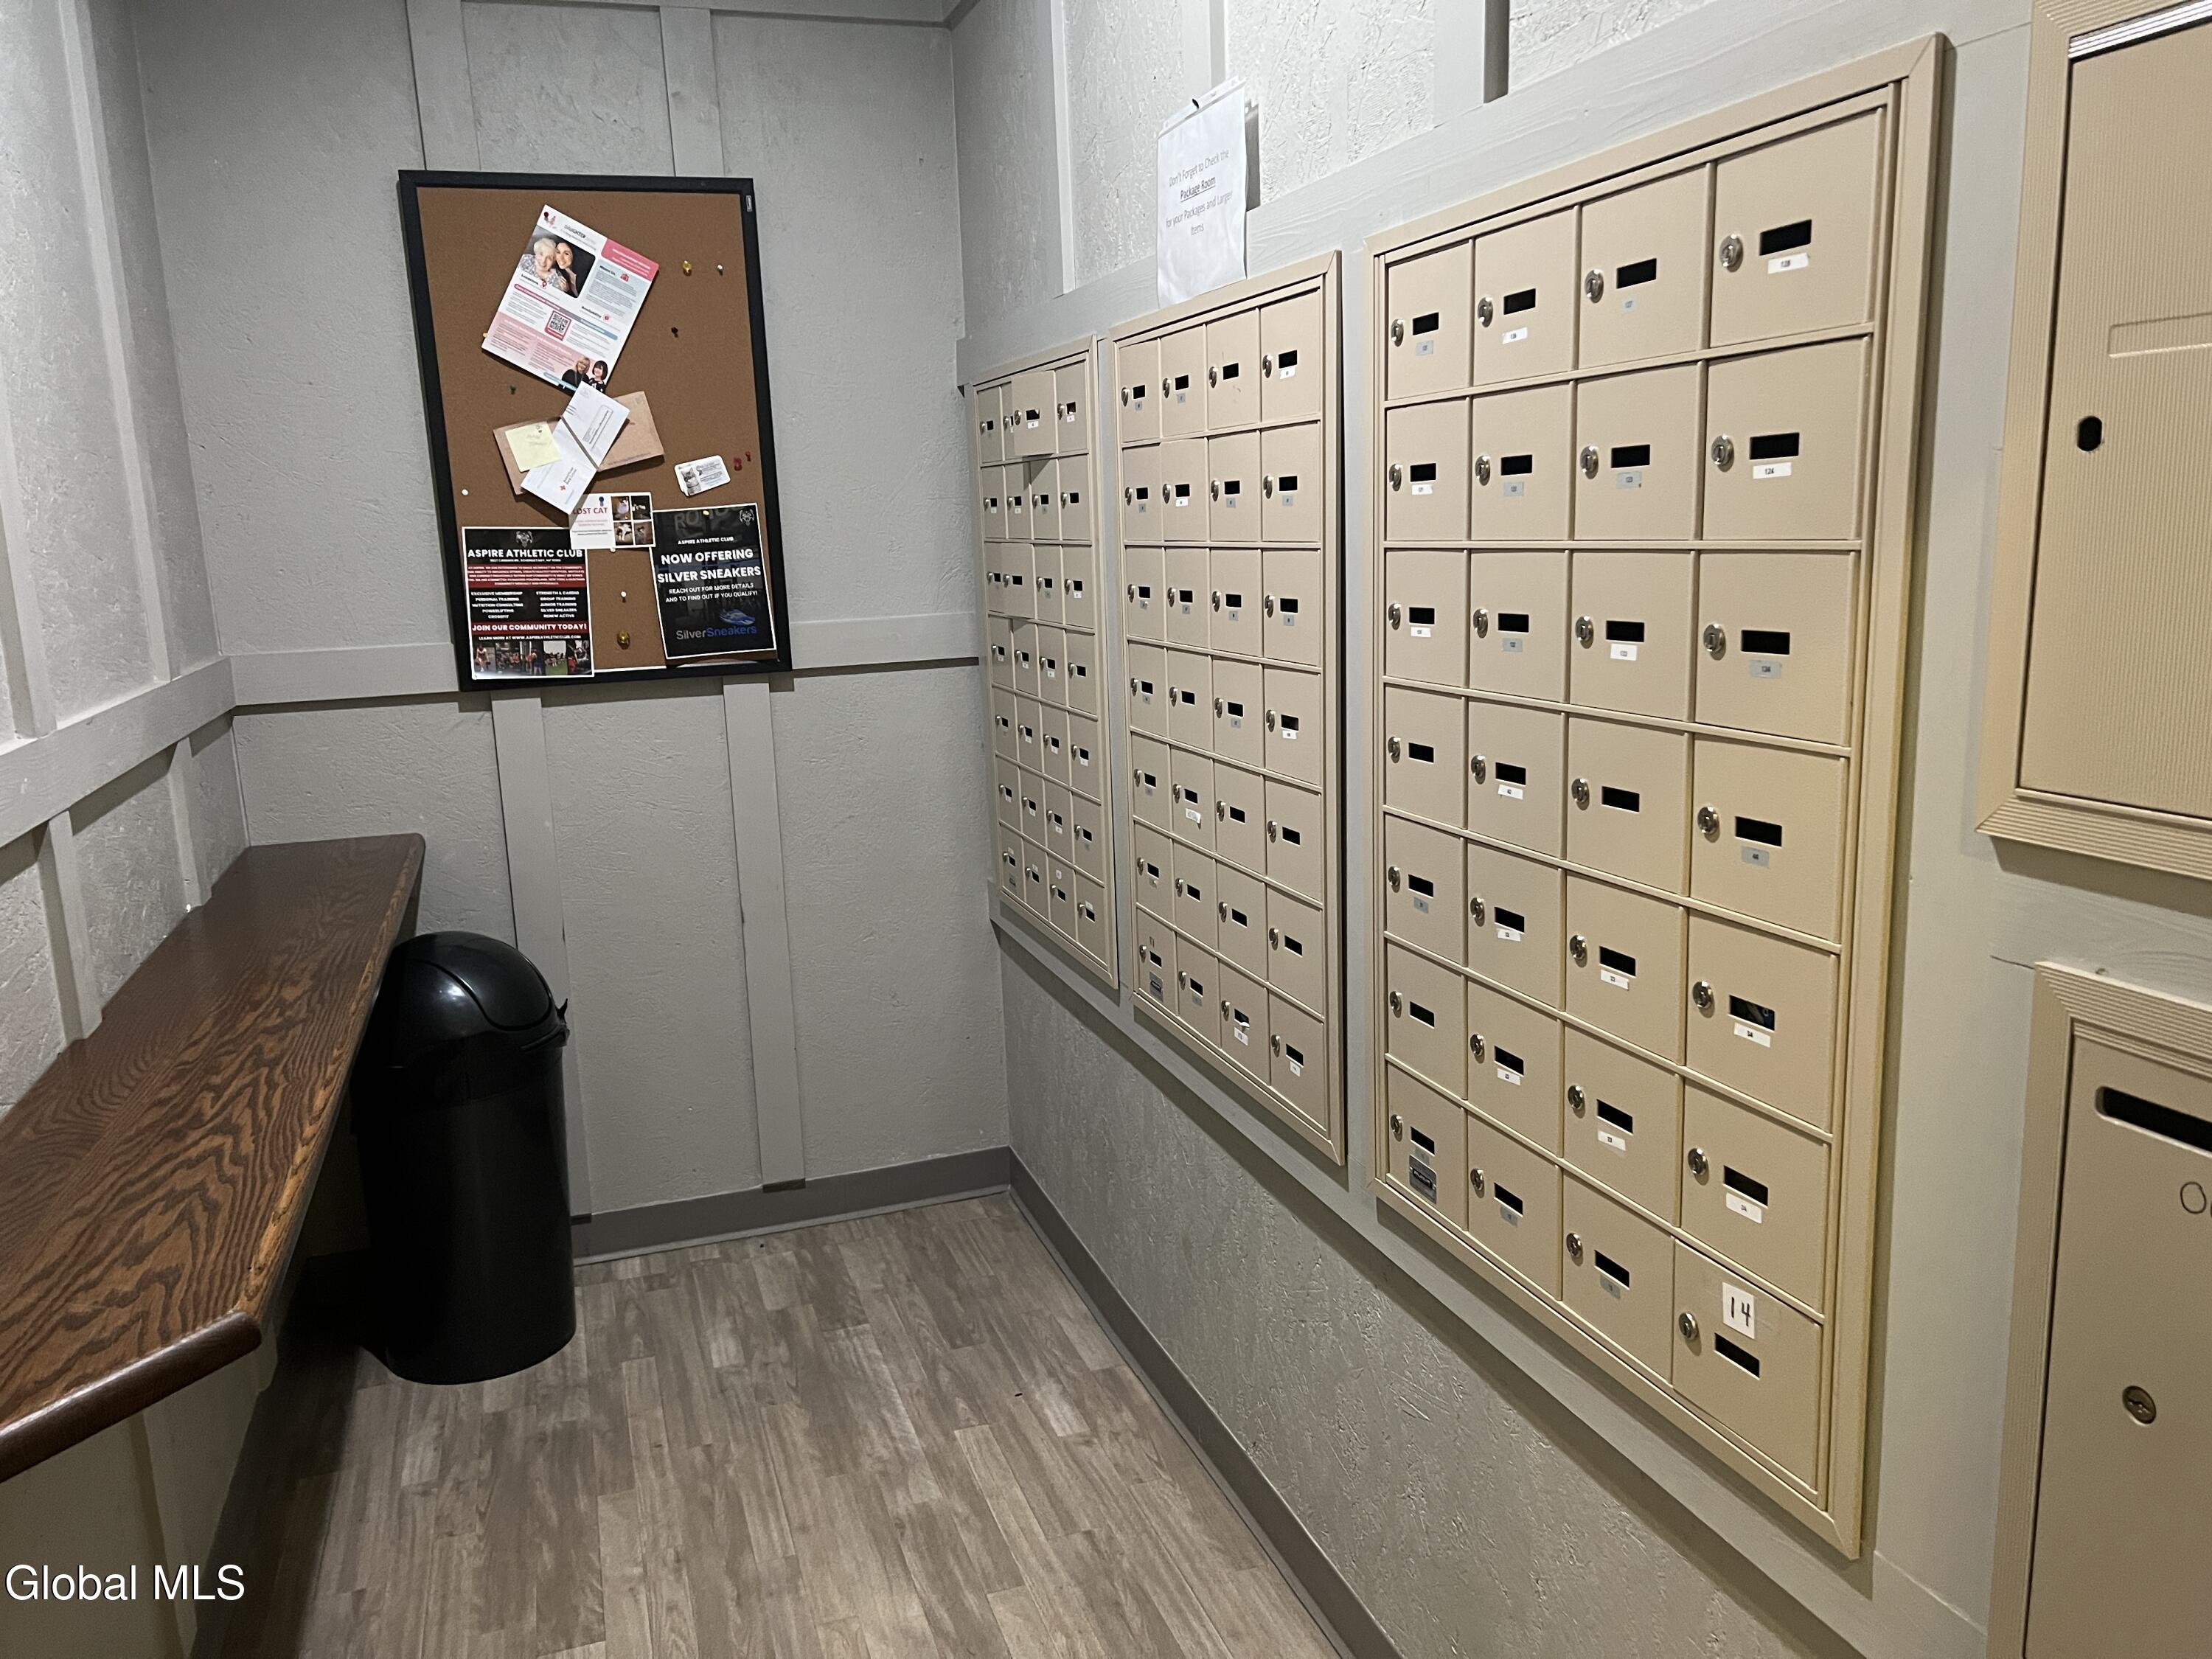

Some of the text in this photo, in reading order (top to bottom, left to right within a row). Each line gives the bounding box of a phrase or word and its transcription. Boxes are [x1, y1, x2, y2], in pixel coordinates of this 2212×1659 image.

[1182, 164, 1198, 180] Forget
[1198, 163, 1204, 173] to
[1205, 153, 1220, 169] Check
[1180, 177, 1216, 200] Package Room
[1173, 213, 1183, 228] your
[1184, 204, 1206, 220] Packages
[1206, 195, 1217, 210] and
[467, 549, 582, 557] ASPIRE ATHLETIC CLUB
[661, 549, 754, 565] NOW OFFERING
[657, 566, 761, 583] SILVER SNEAKERS
[676, 625, 757, 640] SilverSneakers
[1731, 1296, 1751, 1327] 14
